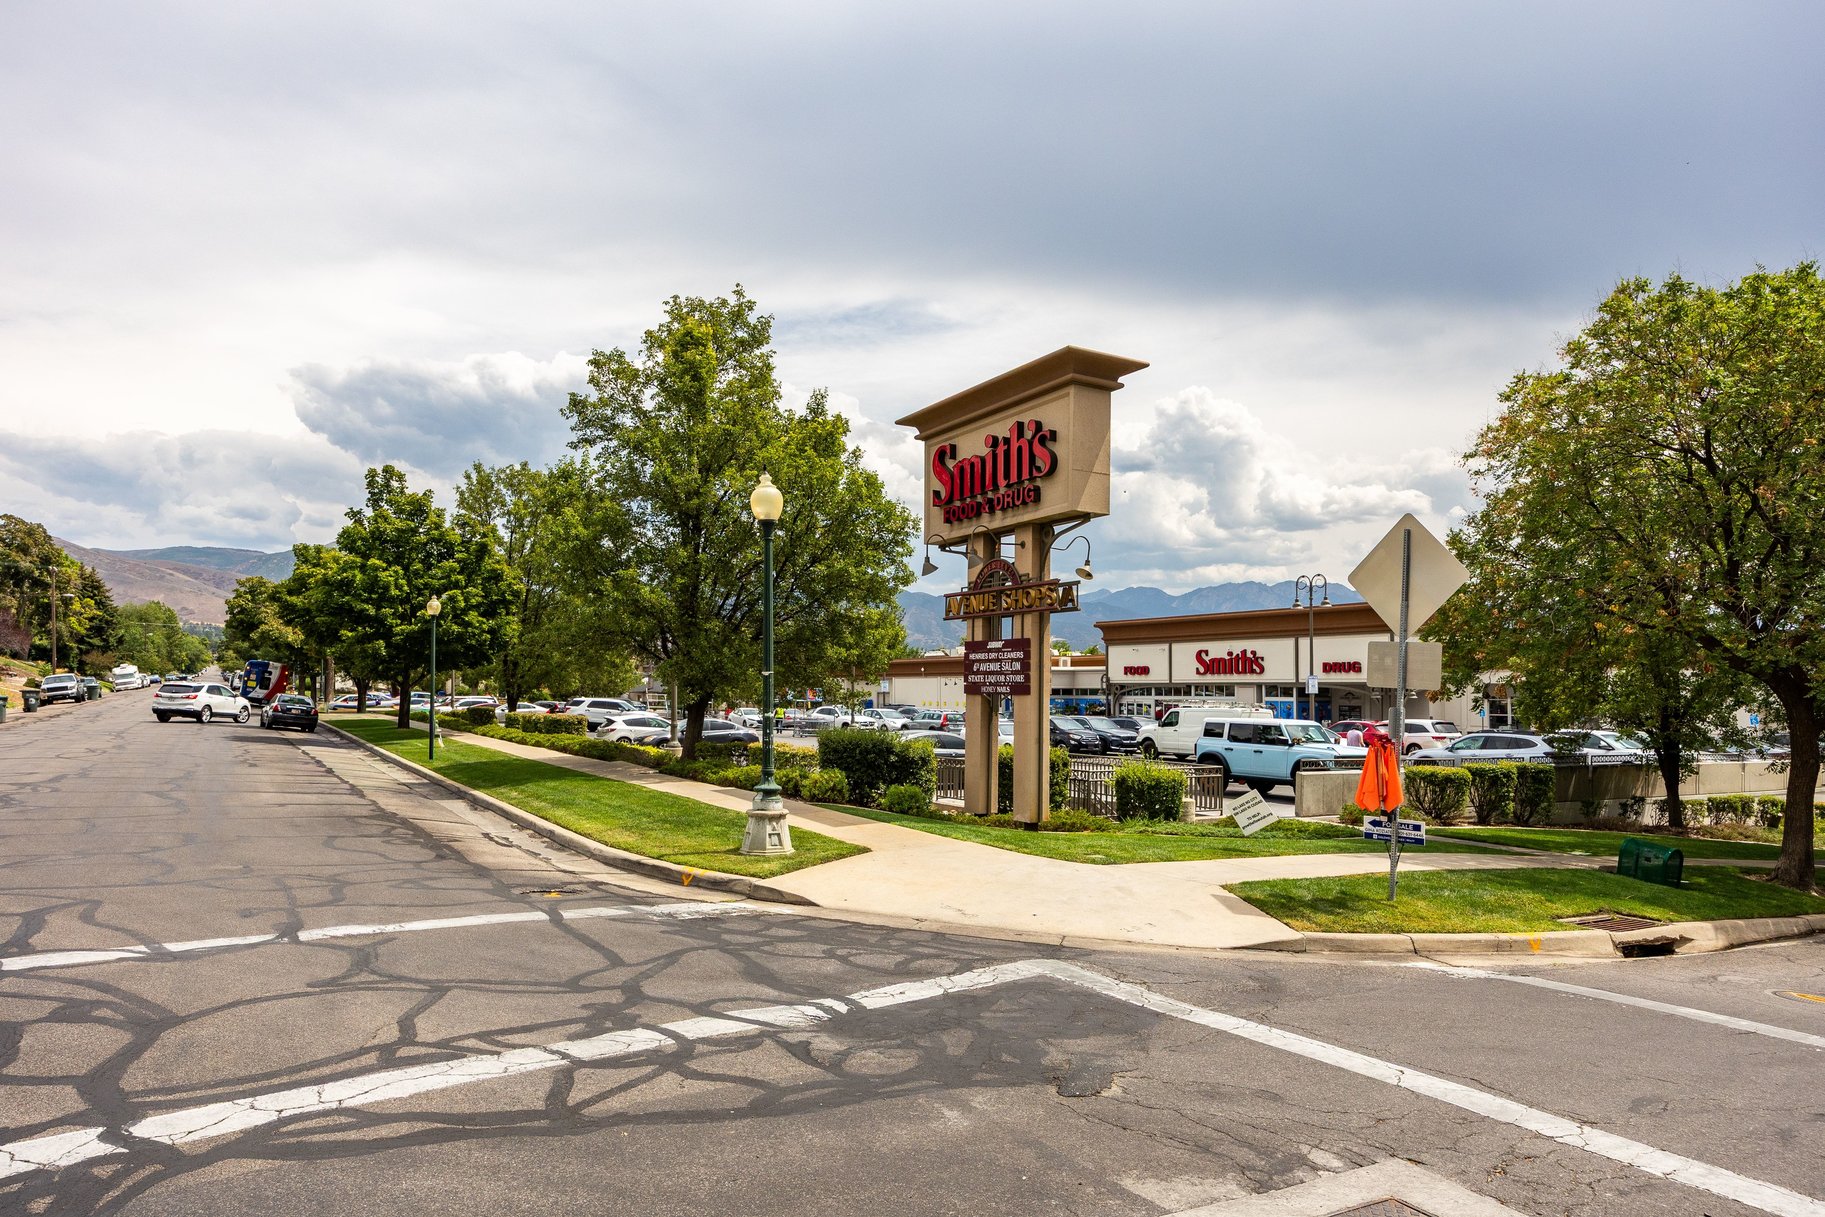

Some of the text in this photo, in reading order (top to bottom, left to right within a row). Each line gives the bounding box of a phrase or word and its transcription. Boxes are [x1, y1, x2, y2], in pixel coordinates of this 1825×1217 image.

[932, 419, 1058, 507] Smith's
[944, 501, 981, 524] FOOD
[994, 484, 1040, 511] DRUG
[946, 592, 997, 616] AVENUE
[1003, 585, 1057, 610] SHOPS
[980, 662, 1000, 671] AVENUE
[1001, 662, 1021, 670] SALON
[998, 651, 1024, 659] CLEANERS
[1124, 649, 1361, 675] FOOD Smith's DRUG
[985, 675, 1007, 683] LIQUOR
